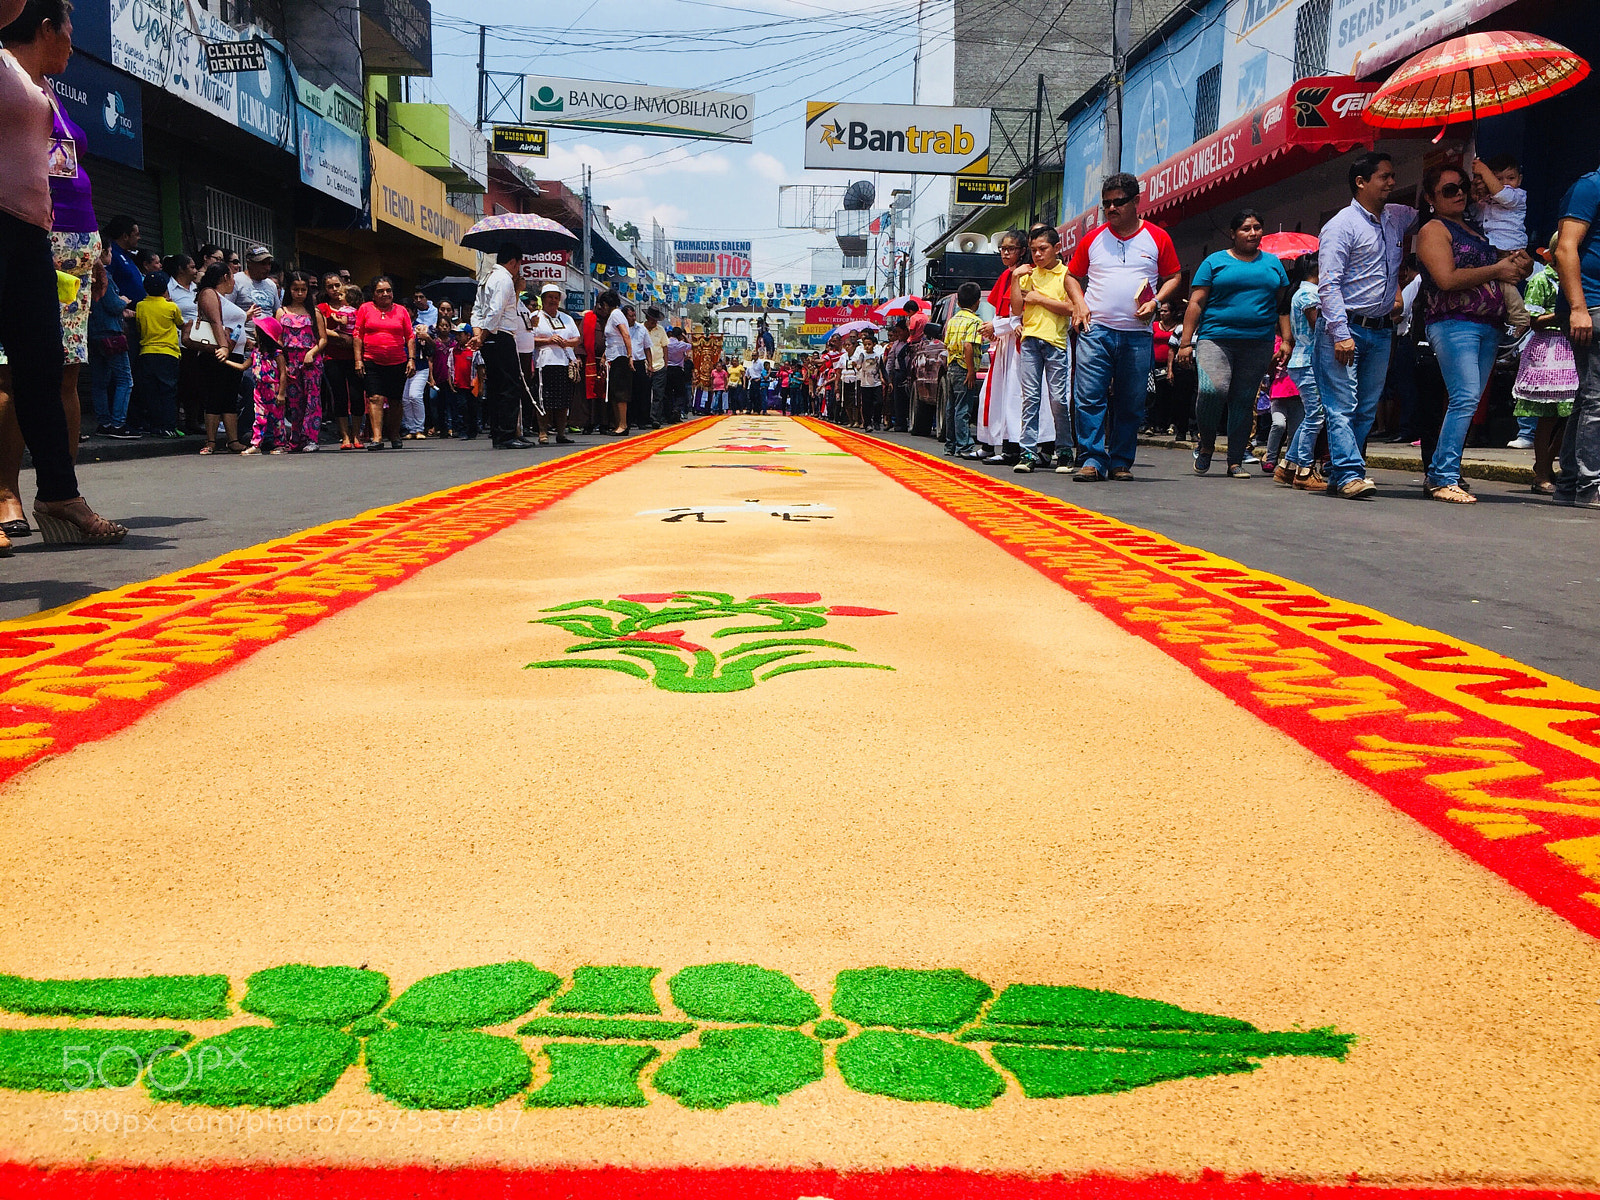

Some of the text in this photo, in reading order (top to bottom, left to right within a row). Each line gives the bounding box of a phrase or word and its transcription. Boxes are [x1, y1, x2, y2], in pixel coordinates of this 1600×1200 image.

[1338, 0, 1385, 48] SECAS
[207, 42, 262, 58] CLINICA
[211, 58, 258, 71] DENTAL
[56, 81, 88, 105] CELULAR
[240, 91, 268, 135] CLINICA
[569, 90, 748, 121] BANCO INMOBILIARIO
[848, 121, 975, 155] Bantrab
[1150, 166, 1172, 202] DIST.
[1173, 158, 1190, 191] LOS
[383, 184, 416, 226] TIENDA
[420, 204, 471, 251] ESQUIPUL
[674, 240, 751, 251] FARMACIAS GALENO
[676, 252, 709, 262] SERVICIO
[522, 265, 562, 279] Sarita
[676, 262, 716, 274] DOMICILIO
[717, 253, 752, 277] 1702
